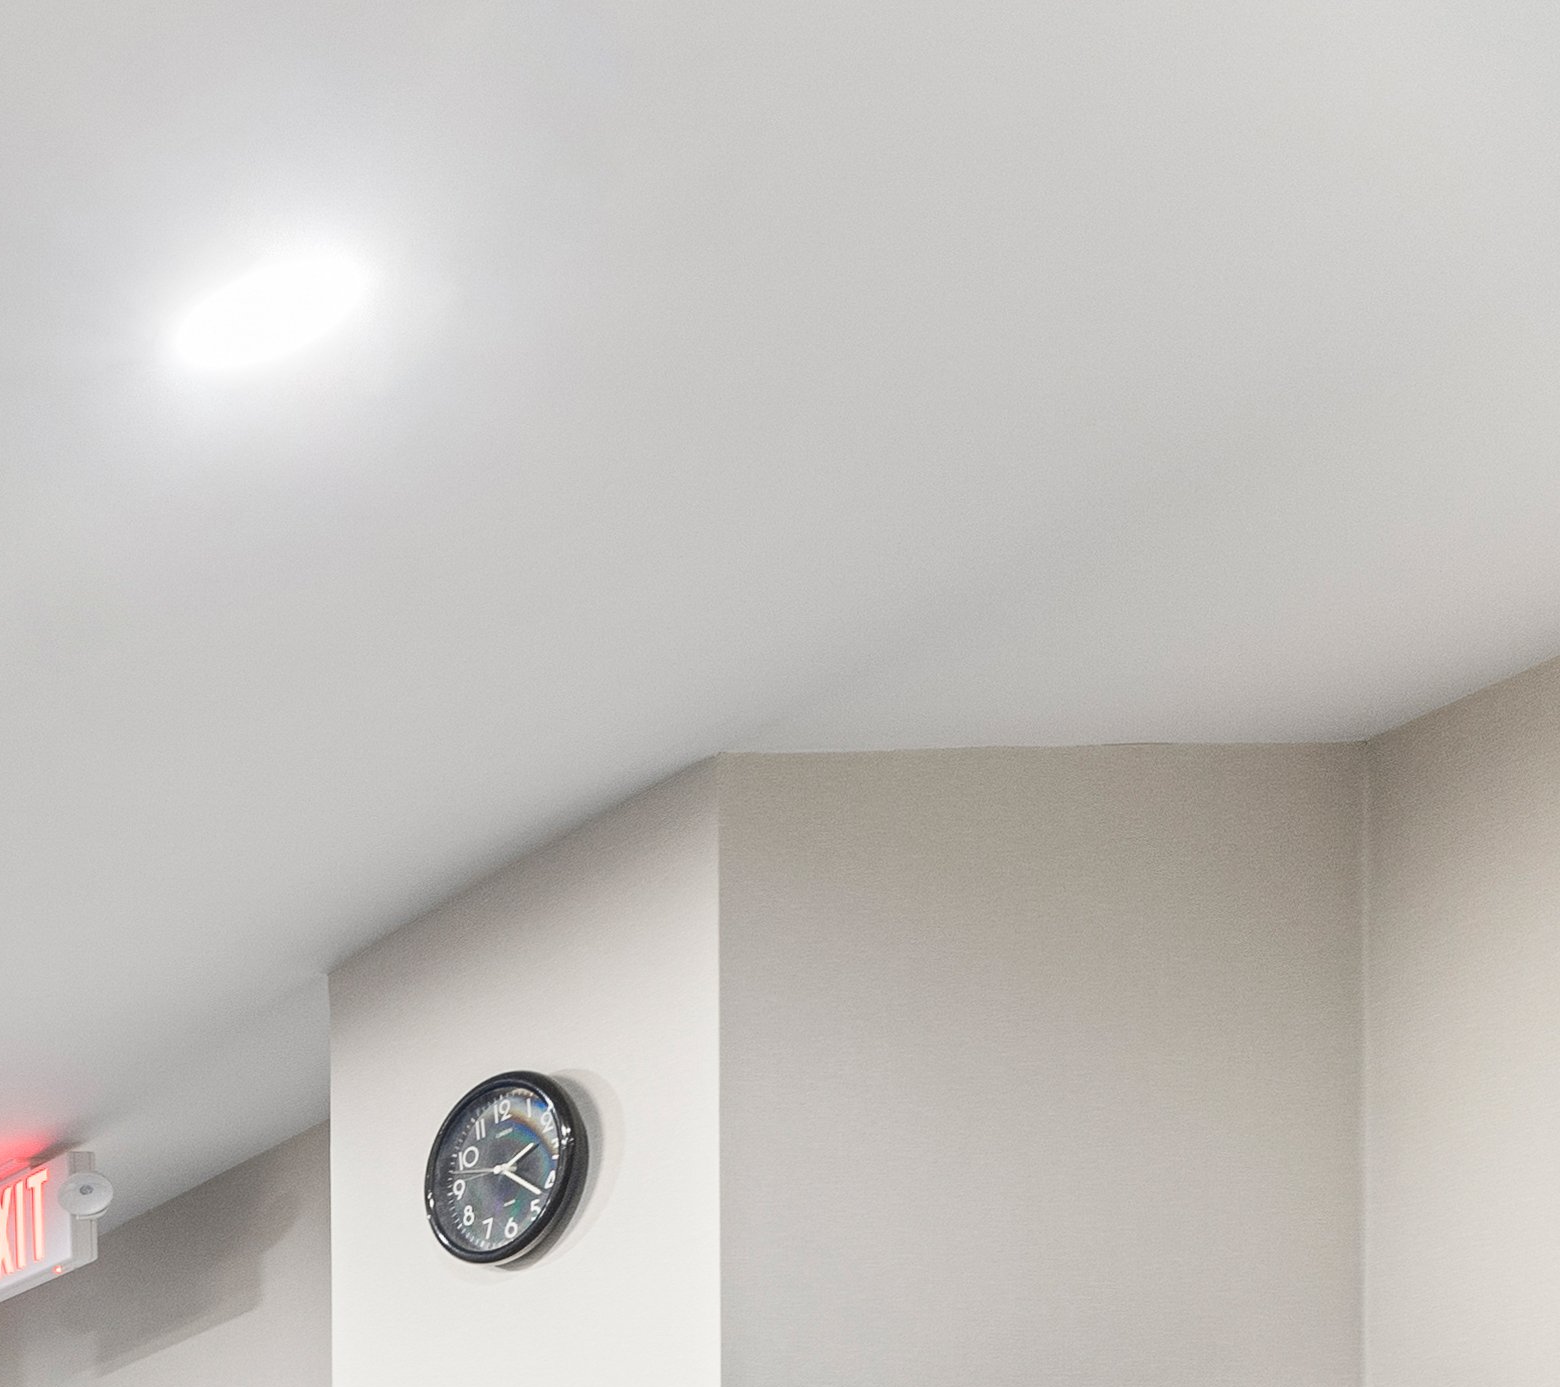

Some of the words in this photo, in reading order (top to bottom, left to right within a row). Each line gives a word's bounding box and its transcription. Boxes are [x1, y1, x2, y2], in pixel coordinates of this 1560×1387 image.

[493, 1099, 512, 1124] 12
[526, 1098, 532, 1118] 1
[475, 1118, 486, 1140] 11
[540, 1111, 555, 1134] 2
[458, 1145, 479, 1171] 10
[452, 1179, 466, 1200] 9
[462, 1205, 475, 1226] 8
[529, 1199, 542, 1221] 5
[482, 1217, 494, 1240] 7
[504, 1216, 519, 1239] 6
